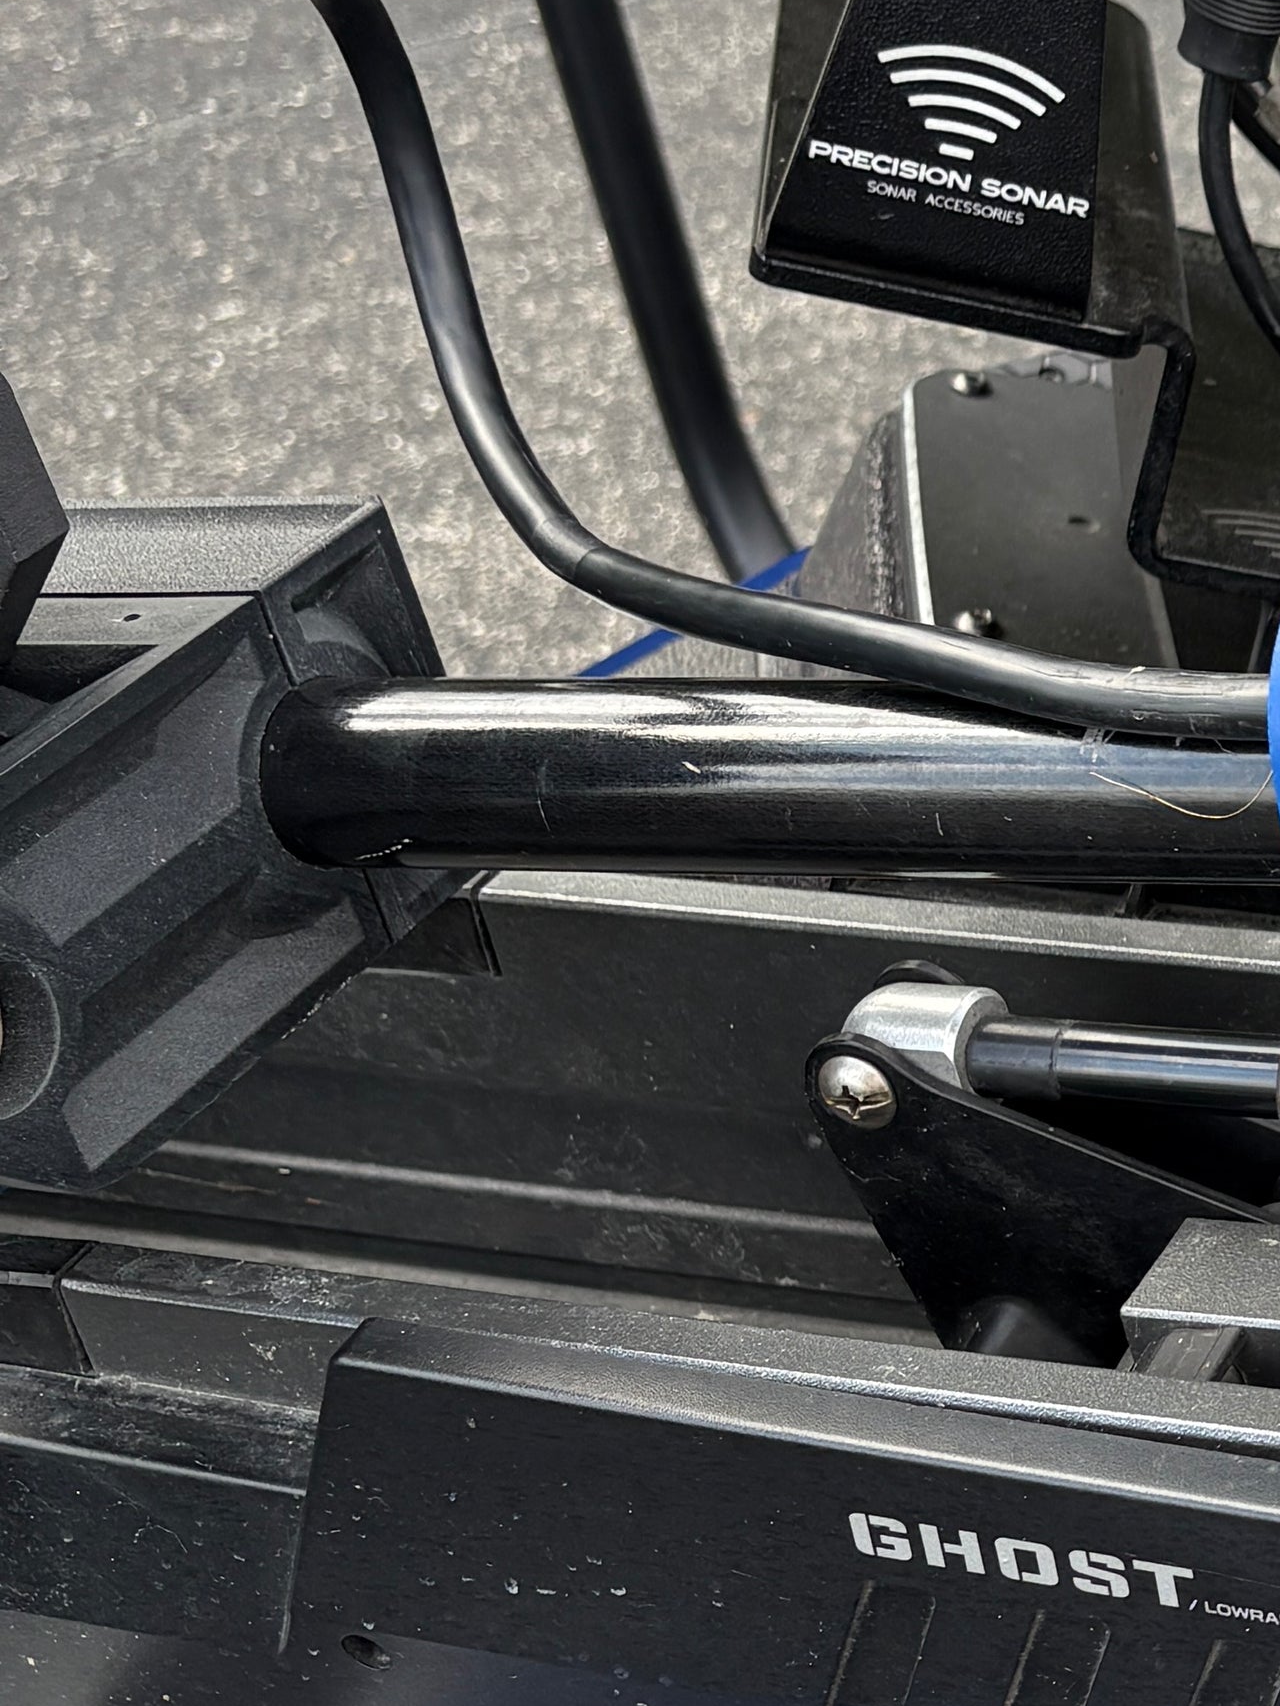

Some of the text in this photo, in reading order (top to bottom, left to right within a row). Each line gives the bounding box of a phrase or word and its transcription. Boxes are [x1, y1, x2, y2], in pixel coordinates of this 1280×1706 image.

[808, 139, 1090, 218] PRECISION SONAR
[866, 179, 1025, 225] SONAR ACCESSORIES
[849, 1512, 1194, 1608] GHOST
